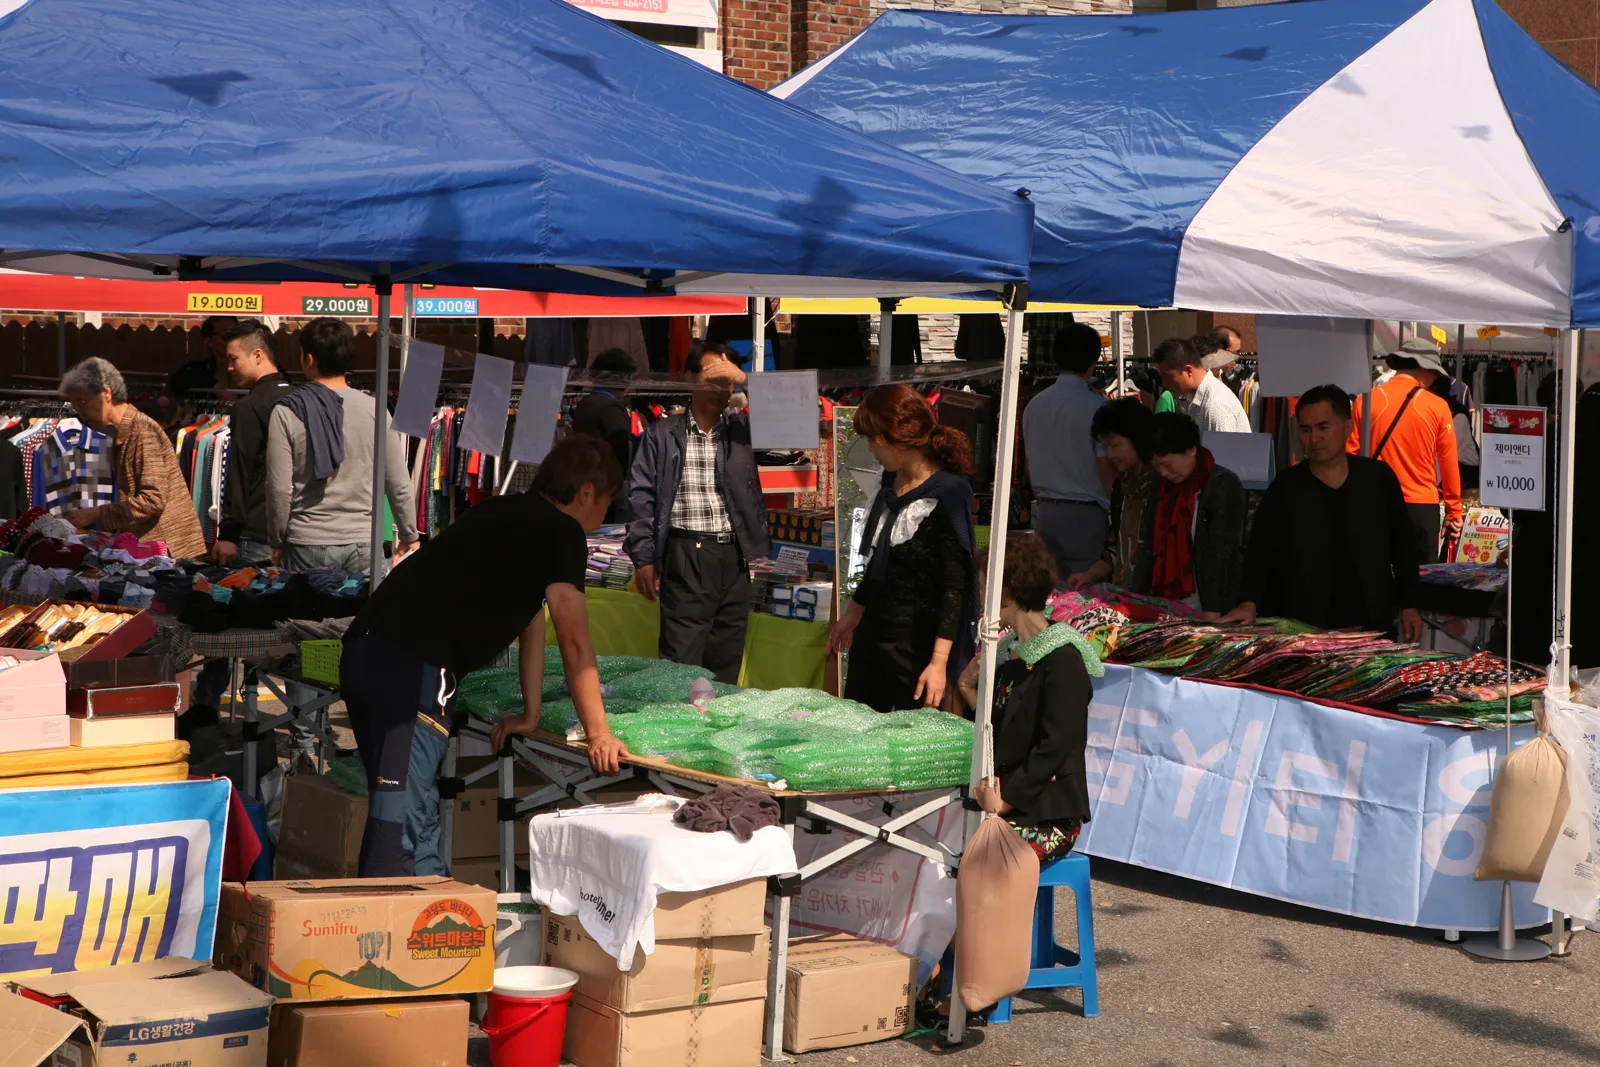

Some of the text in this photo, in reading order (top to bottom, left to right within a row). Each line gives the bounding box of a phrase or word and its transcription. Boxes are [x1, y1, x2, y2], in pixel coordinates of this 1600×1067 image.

[192, 296, 258, 310] 19.000원
[306, 299, 368, 313] 29.000원
[416, 300, 476, 313] 39.000원
[1495, 443, 1531, 456] 제이앤디
[1496, 475, 1535, 491] 10,000
[423, 901, 473, 918] 고당도 바나나
[301, 919, 358, 937] Sumifru
[407, 930, 485, 949] 스위트마운틴
[412, 947, 480, 960] Sweet Mountain
[129, 1022, 195, 1041] LG생활건강
